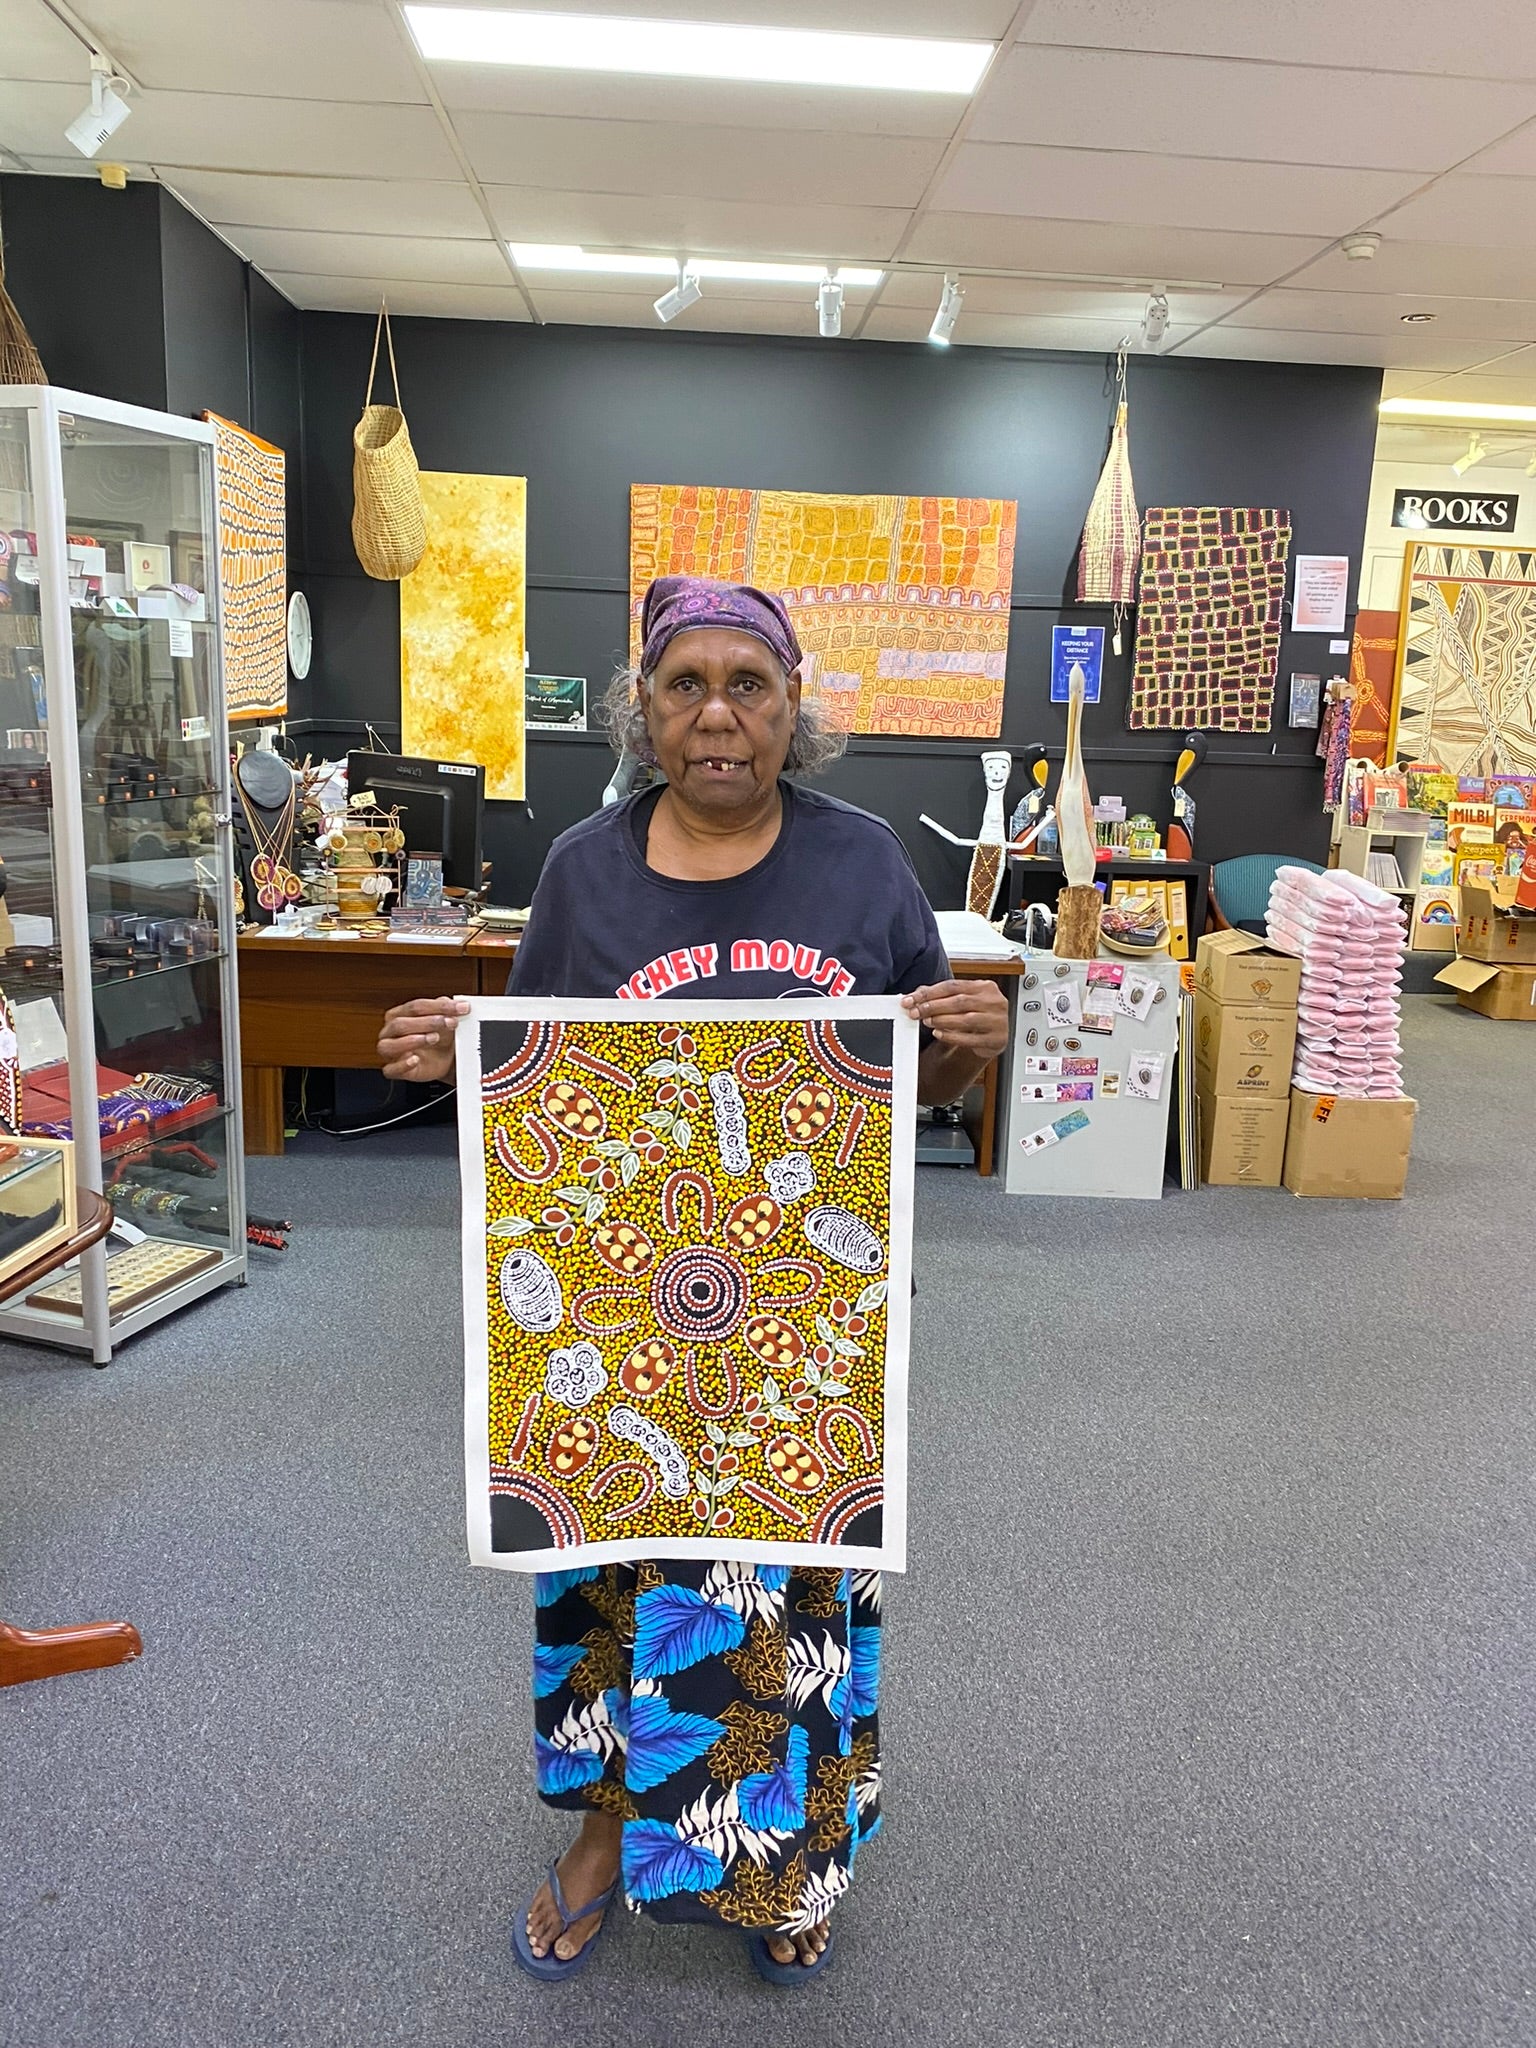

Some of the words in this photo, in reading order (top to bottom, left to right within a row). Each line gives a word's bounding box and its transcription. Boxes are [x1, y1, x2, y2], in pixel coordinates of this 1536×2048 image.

[1402, 496, 1508, 525] BOOKS
[1466, 779, 1485, 788] Kun
[1454, 808, 1489, 824] MILBI
[1500, 814, 1536, 824] CEREMON
[1464, 846, 1501, 855] respect
[615, 943, 718, 999] CKEY
[731, 939, 856, 998] MOUSE
